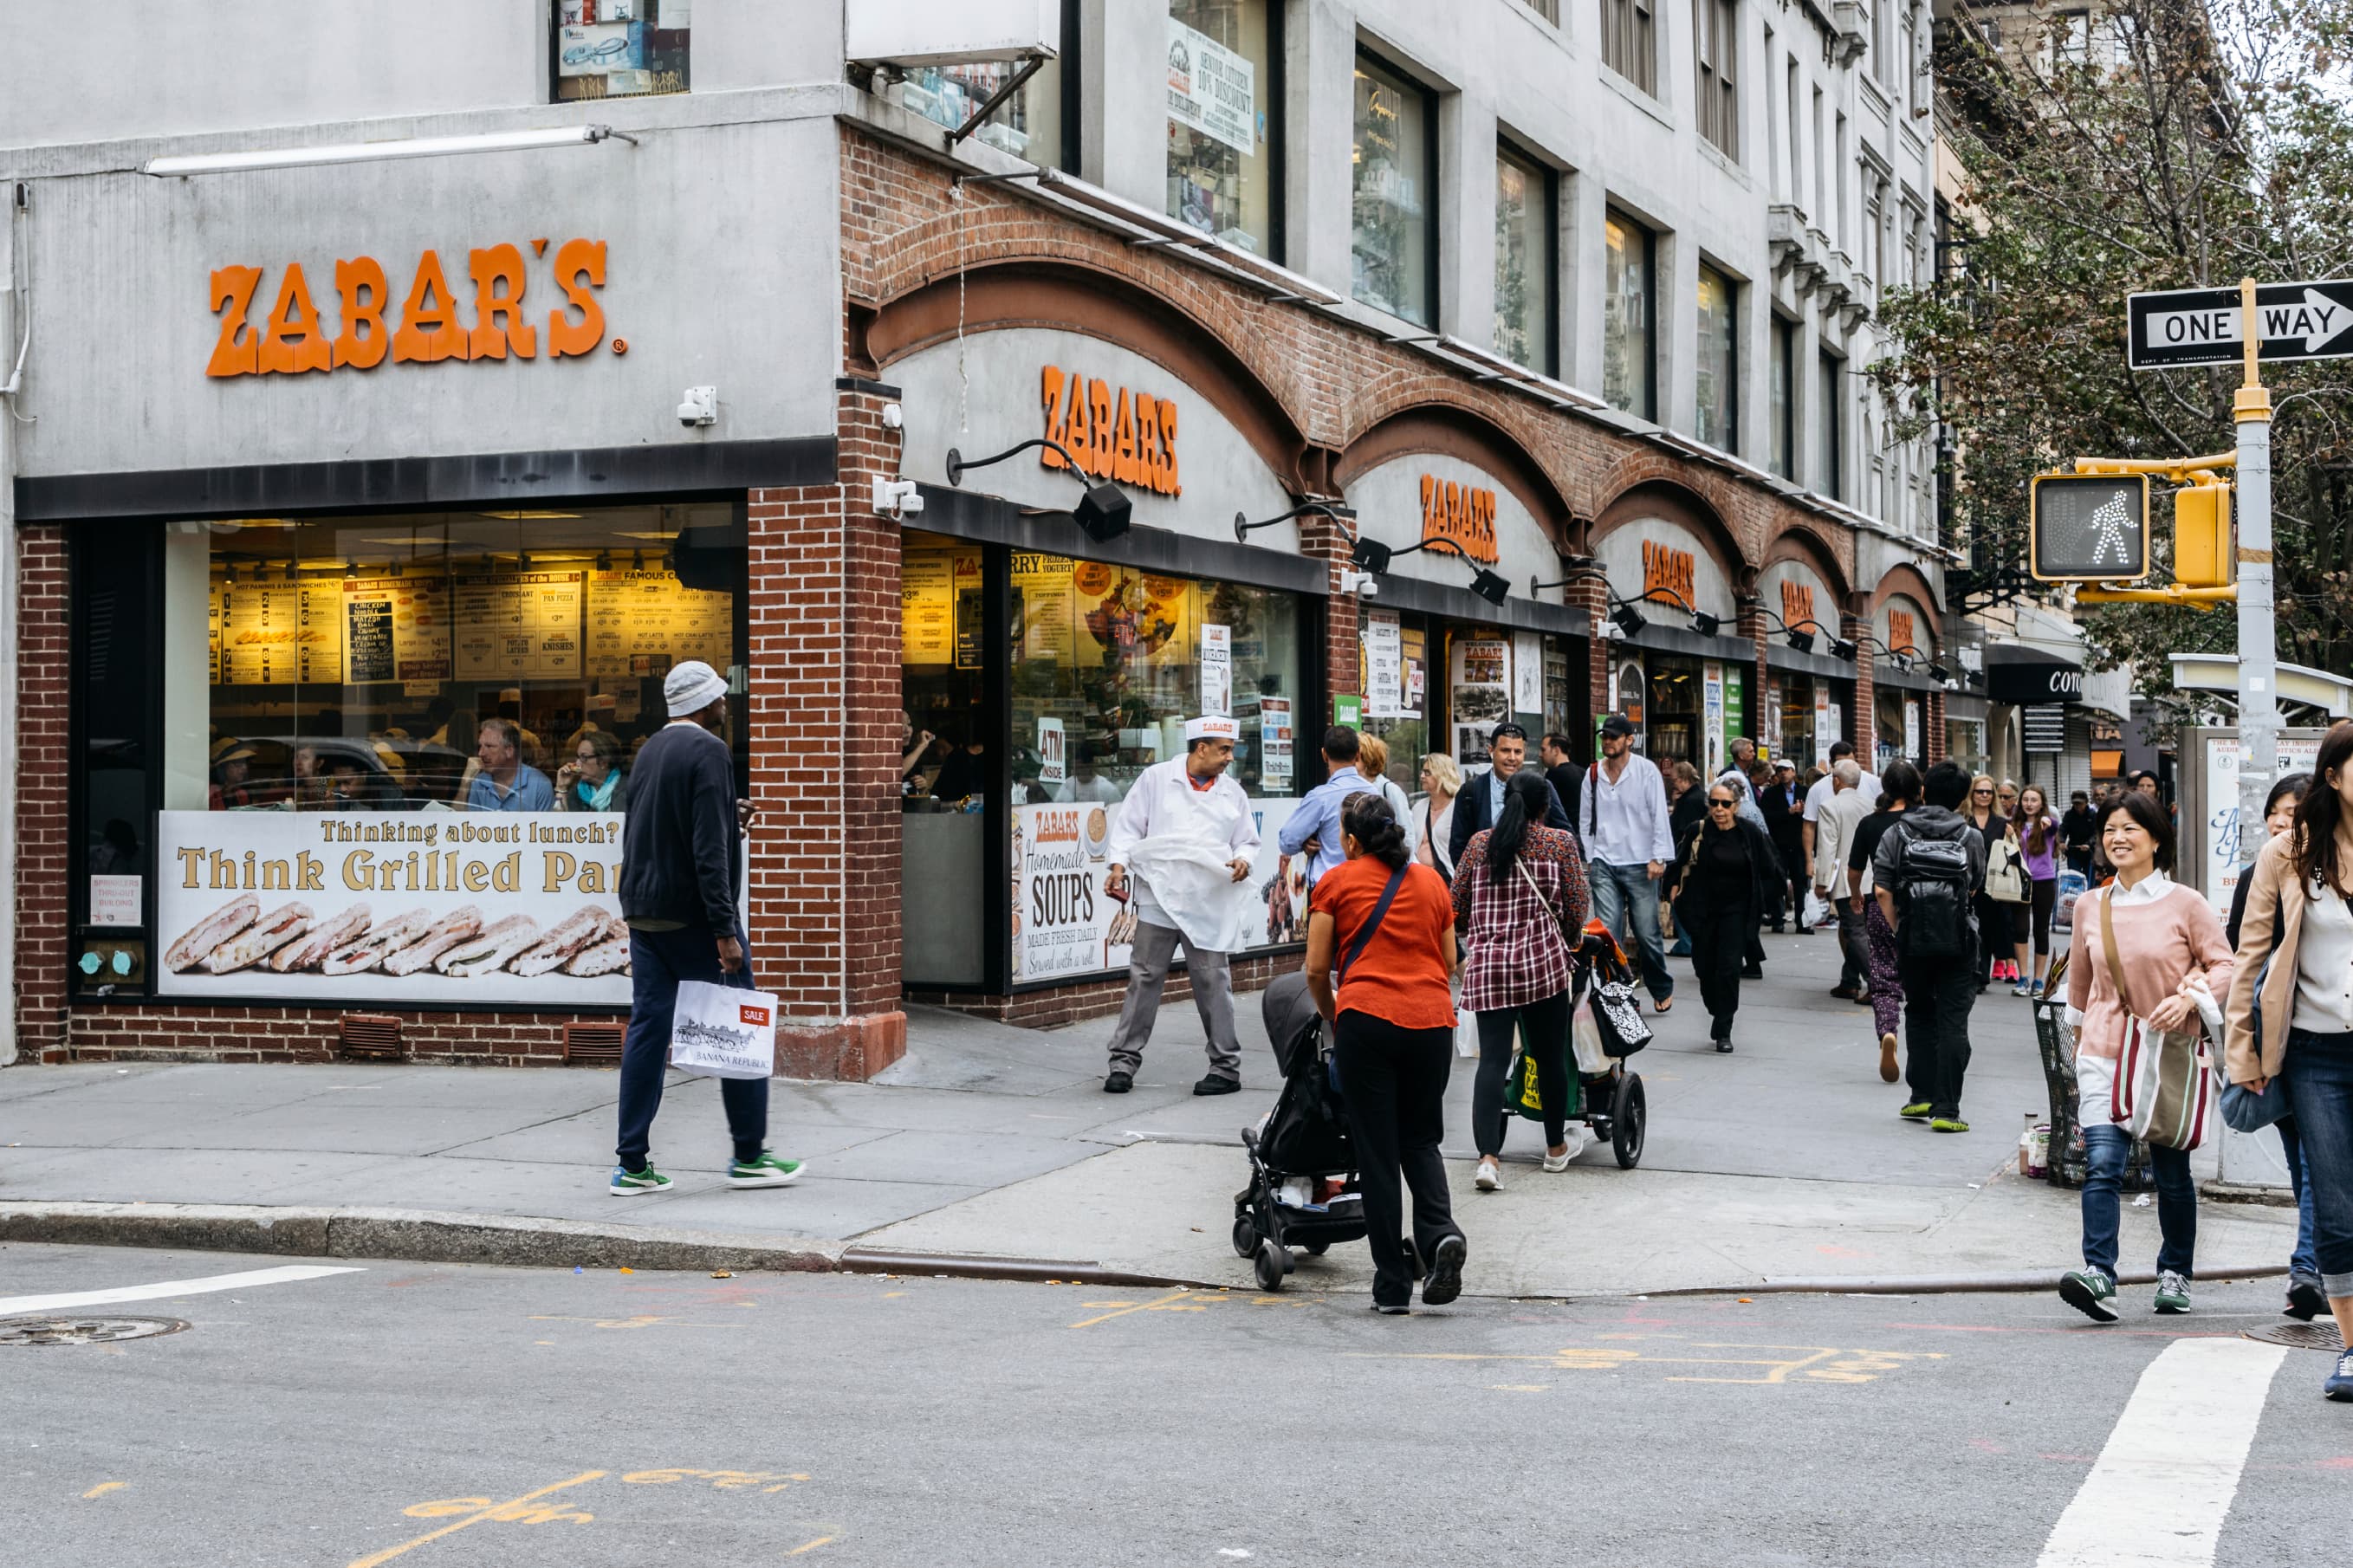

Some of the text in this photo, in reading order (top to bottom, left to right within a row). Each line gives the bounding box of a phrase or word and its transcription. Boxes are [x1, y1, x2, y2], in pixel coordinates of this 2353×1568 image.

[1215, 78, 1251, 114] DISCOUNT
[205, 237, 607, 377] ZABAR'S
[2165, 305, 2337, 343] ONE WAY
[548, 573, 570, 582] HOUSE
[1042, 564, 1074, 573] YOGURT
[542, 642, 574, 651] KNISHES
[1040, 729, 1063, 762] ATM
[321, 820, 620, 846] Thinking about lunch?
[1025, 837, 1085, 873] Homemade
[177, 846, 325, 891] Think
[342, 848, 522, 892] Grilled
[1032, 871, 1094, 928] SOUPS
[1027, 927, 1099, 949] MADE FRESH DAILY
[1028, 949, 1054, 975] Served
[1056, 950, 1073, 969] with
[744, 1010, 764, 1021] SALE
[697, 1052, 769, 1069] BANANA REPUBLIC
[2094, 1278, 2107, 1293] N
